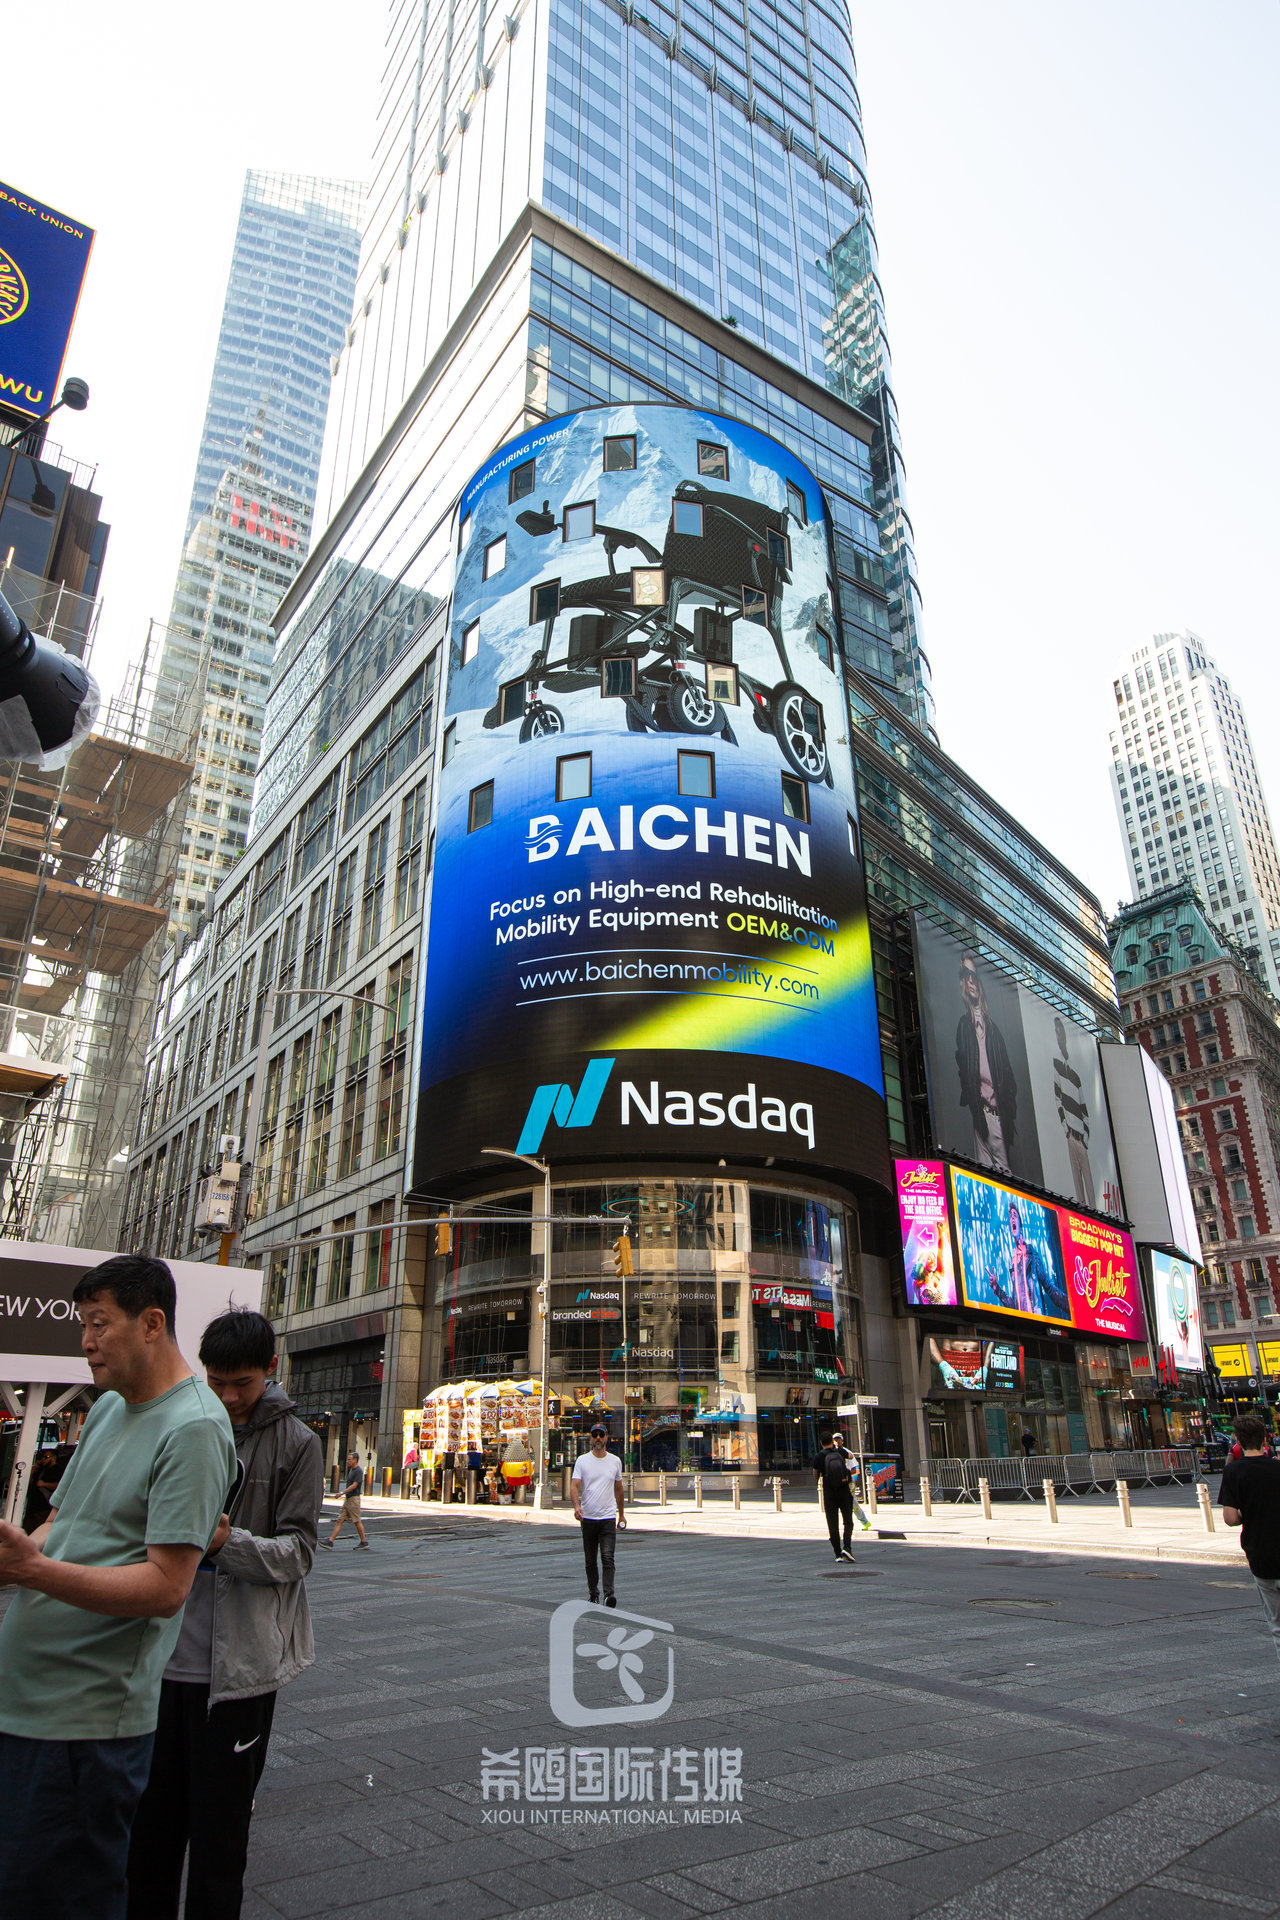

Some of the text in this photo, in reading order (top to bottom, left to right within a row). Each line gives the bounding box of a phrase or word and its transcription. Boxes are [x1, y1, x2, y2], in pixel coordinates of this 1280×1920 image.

[0, 190, 84, 240] BACK UNION
[466, 429, 570, 504] MANUFACTURING POWER
[524, 804, 813, 878] BAICHEN
[489, 879, 839, 934] Focus on High-end Rehabilitation
[495, 907, 835, 957] Mobility Equipment OEM&ODM
[519, 958, 820, 1000] www.baichenmobility.com
[620, 1081, 816, 1150] Nasdaq
[900, 1171, 942, 1188] Juliet
[900, 1194, 917, 1205] ENJOY
[926, 1196, 938, 1206] FEES
[938, 1196, 945, 1206] AT
[904, 1204, 915, 1214] THE
[926, 1205, 943, 1216] OFFICE
[1068, 1215, 1123, 1244] BROADWAY'S
[1070, 1228, 1125, 1258] BIGGEST POP HIT
[590, 1291, 717, 1301] Nasdaq REWRITE TOMORROW
[1086, 1259, 1131, 1308] Juliet
[490, 1298, 523, 1308] TOMORROW
[1095, 1318, 1127, 1332] THE MUSICAL
[631, 1346, 674, 1359] Nasdaq
